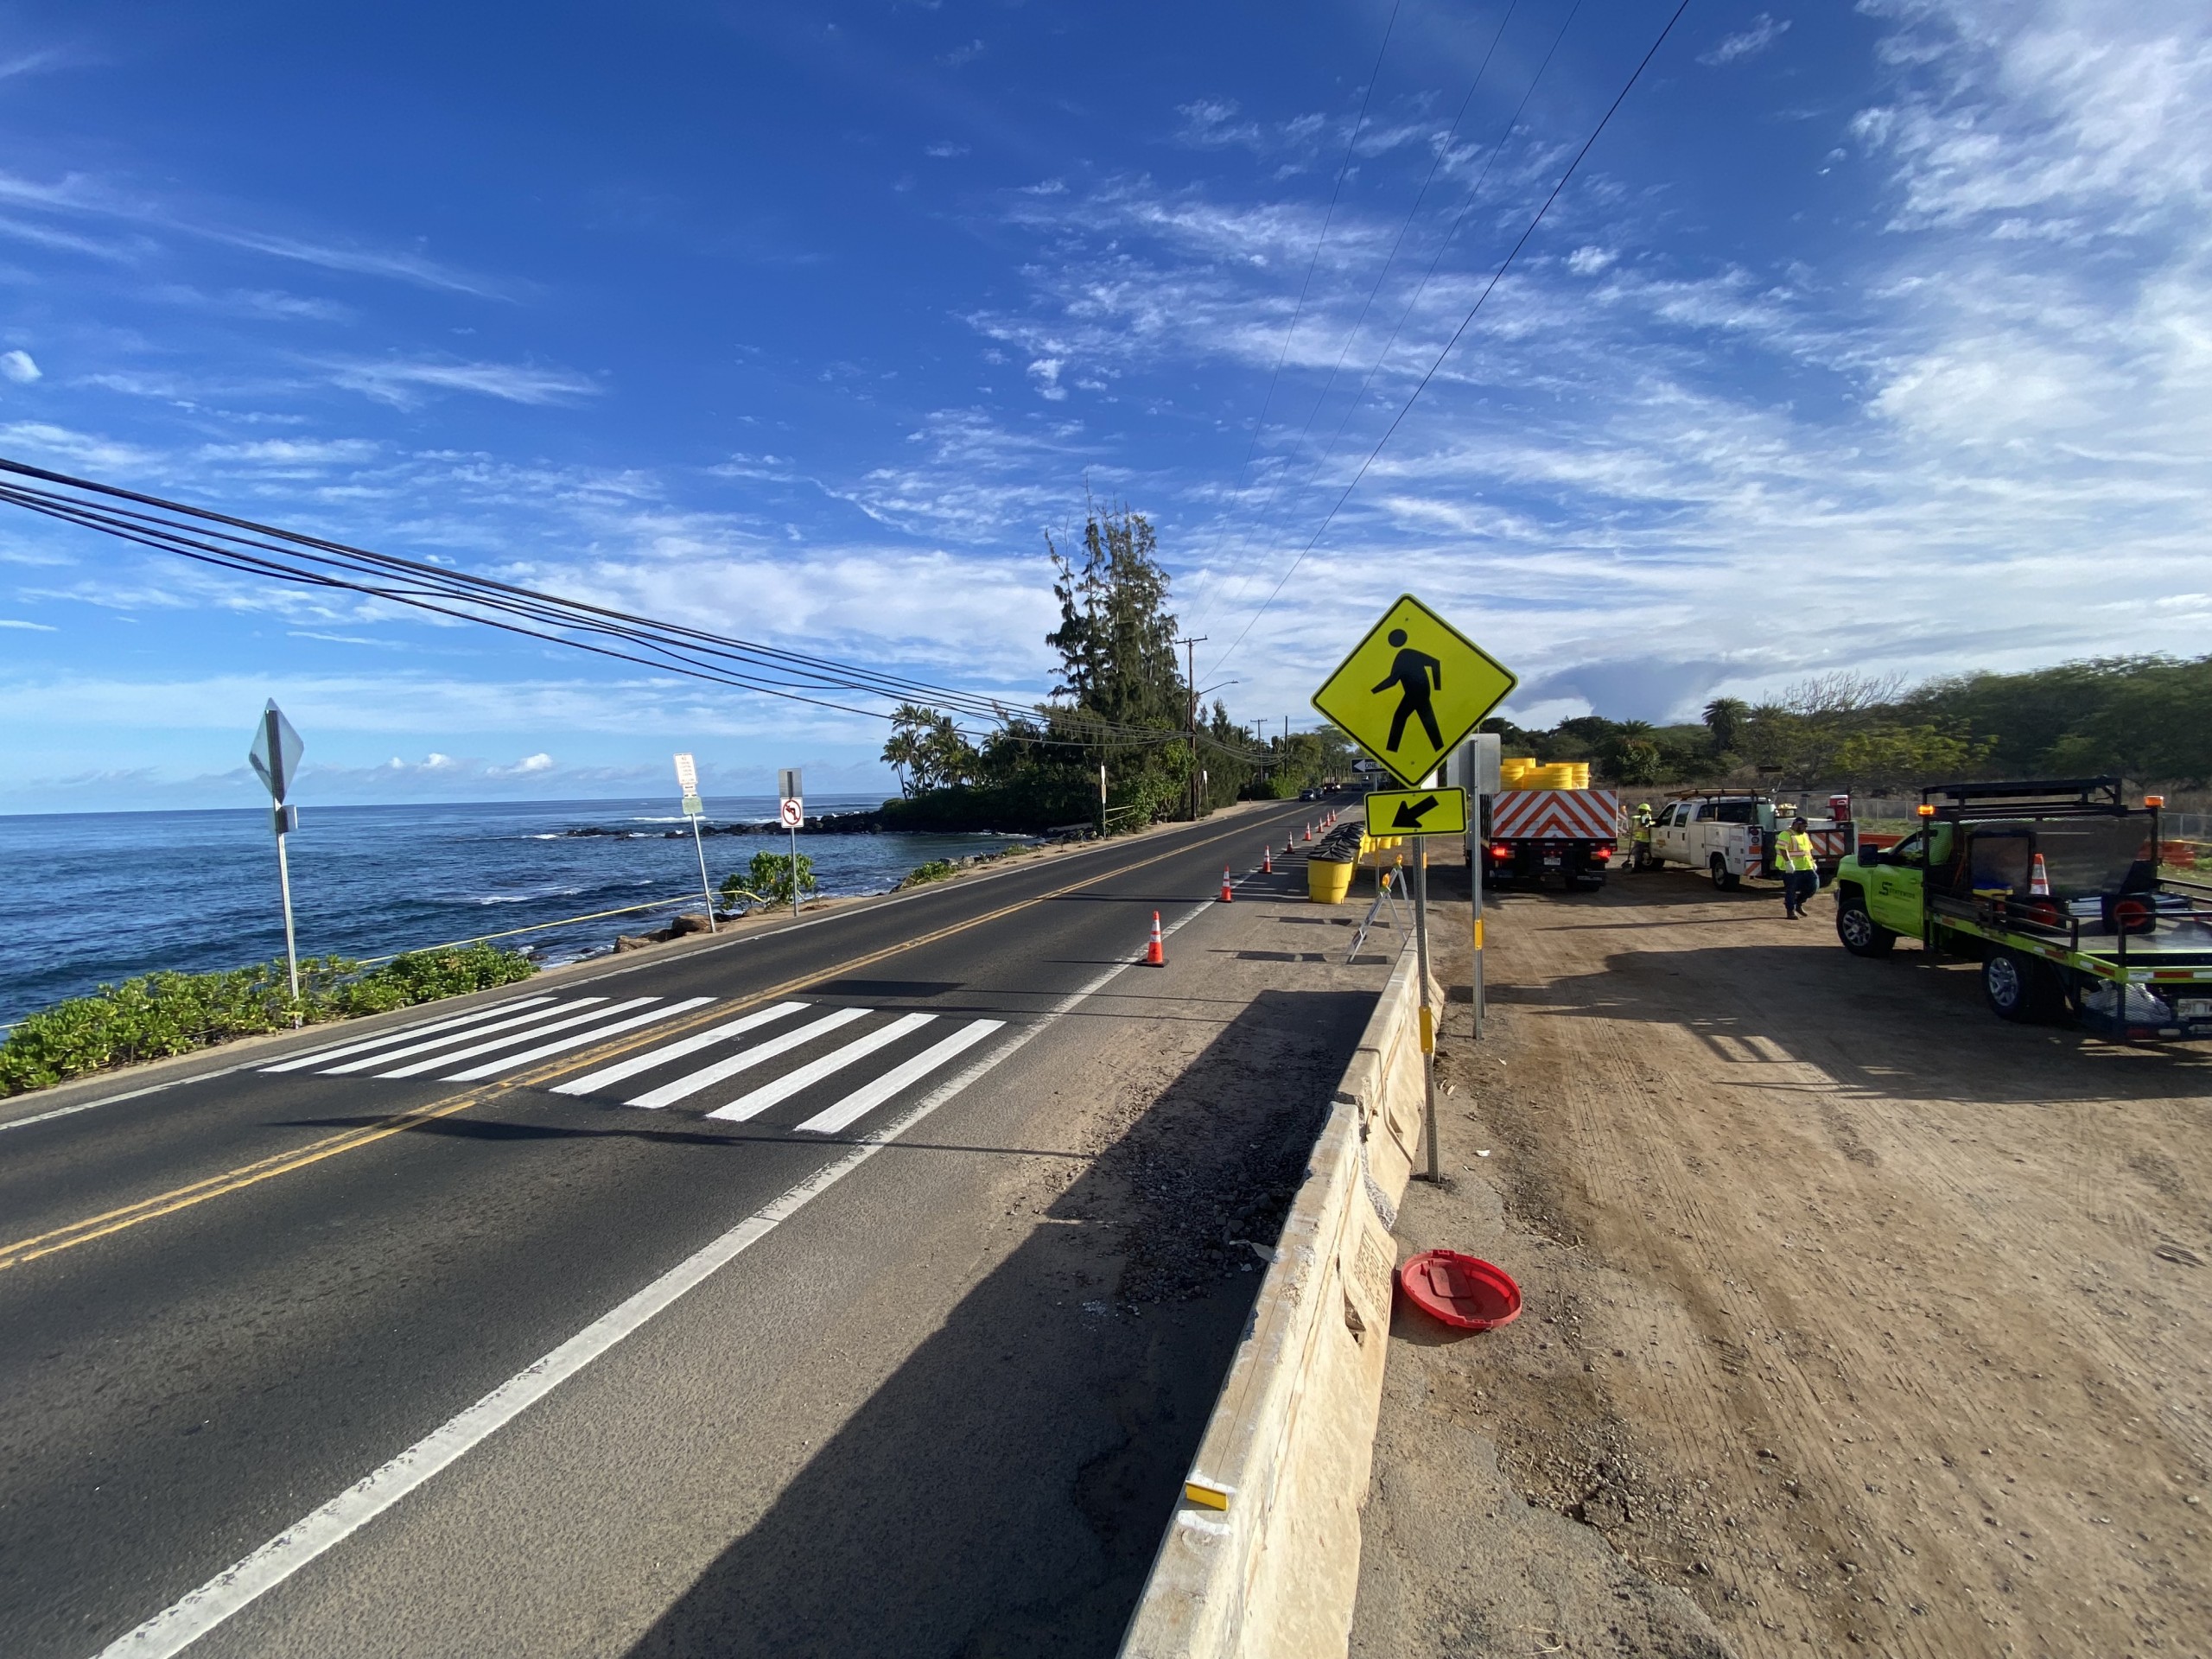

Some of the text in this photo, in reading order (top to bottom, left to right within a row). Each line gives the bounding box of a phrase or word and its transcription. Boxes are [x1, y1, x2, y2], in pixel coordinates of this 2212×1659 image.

[1353, 1223, 1371, 1290] PROPERTY
[1363, 1246, 1380, 1305] OF HDOT
[1374, 1259, 1390, 1322] OCT 2001
